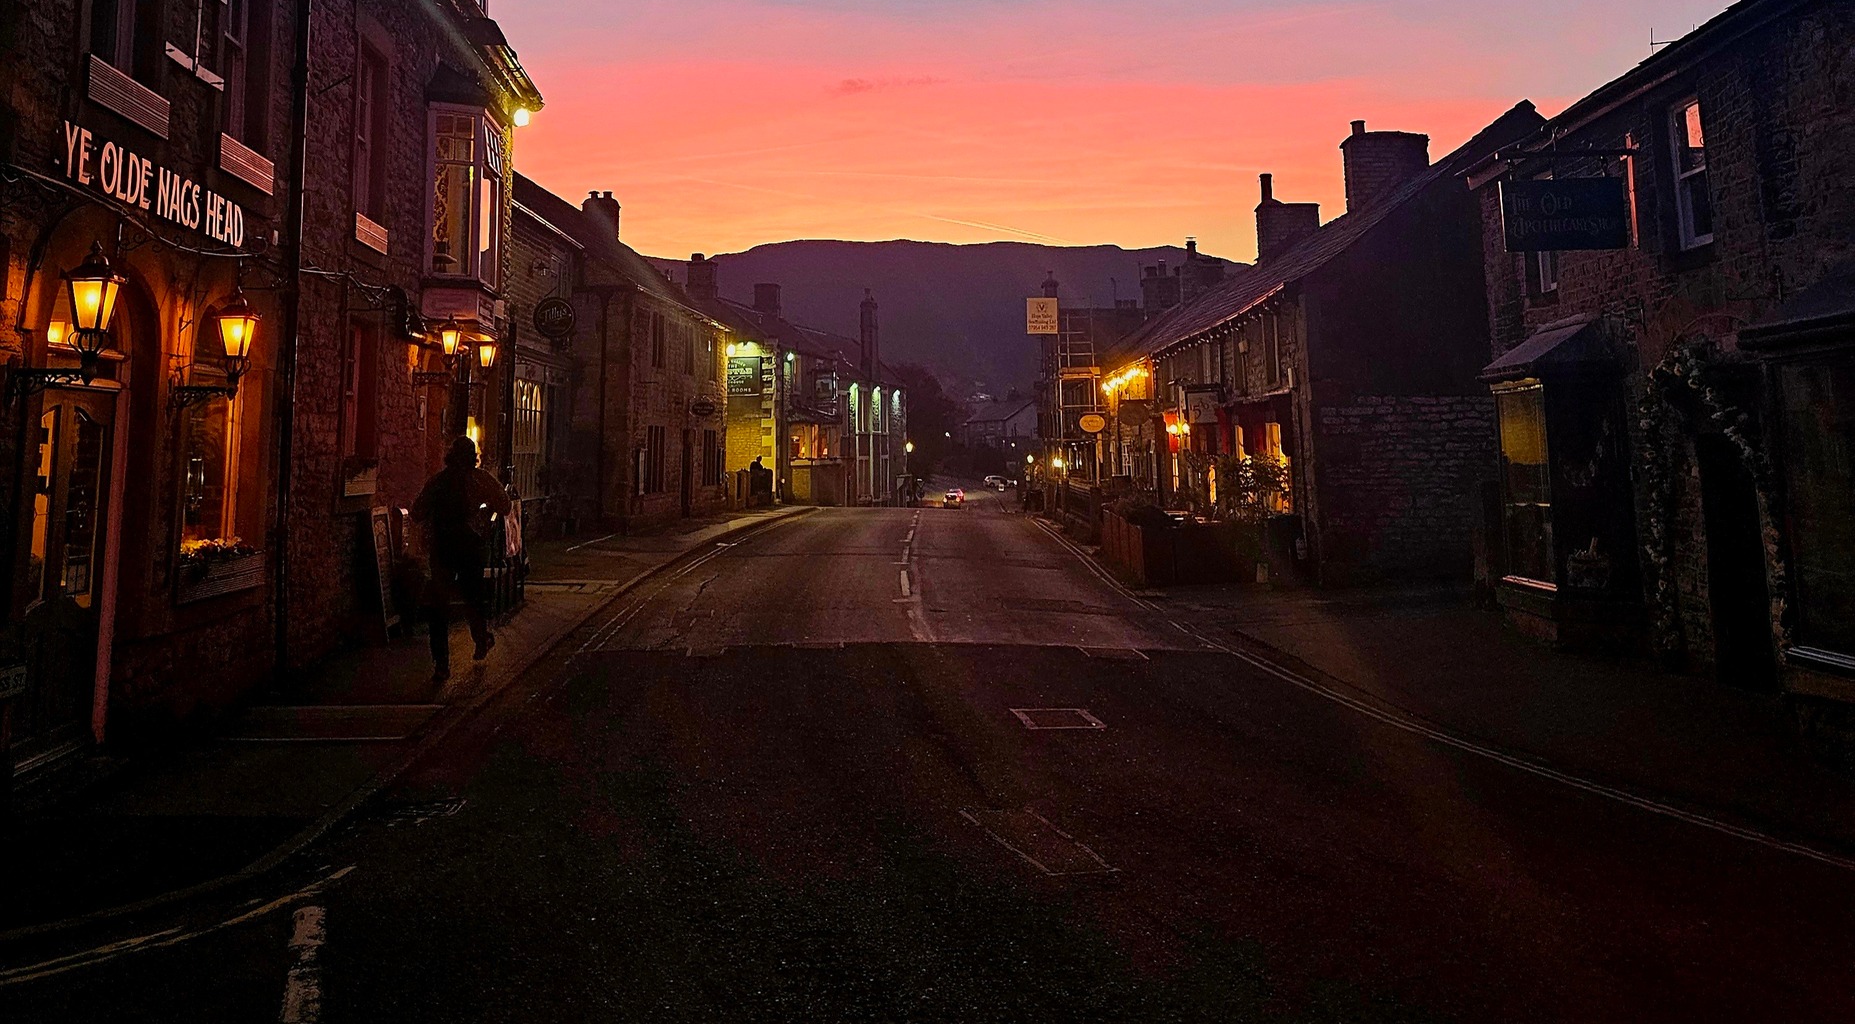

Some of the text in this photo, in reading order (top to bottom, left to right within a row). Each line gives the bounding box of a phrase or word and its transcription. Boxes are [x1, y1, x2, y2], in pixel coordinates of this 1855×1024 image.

[64, 119, 244, 248] YE OLDE NAGS HEAD
